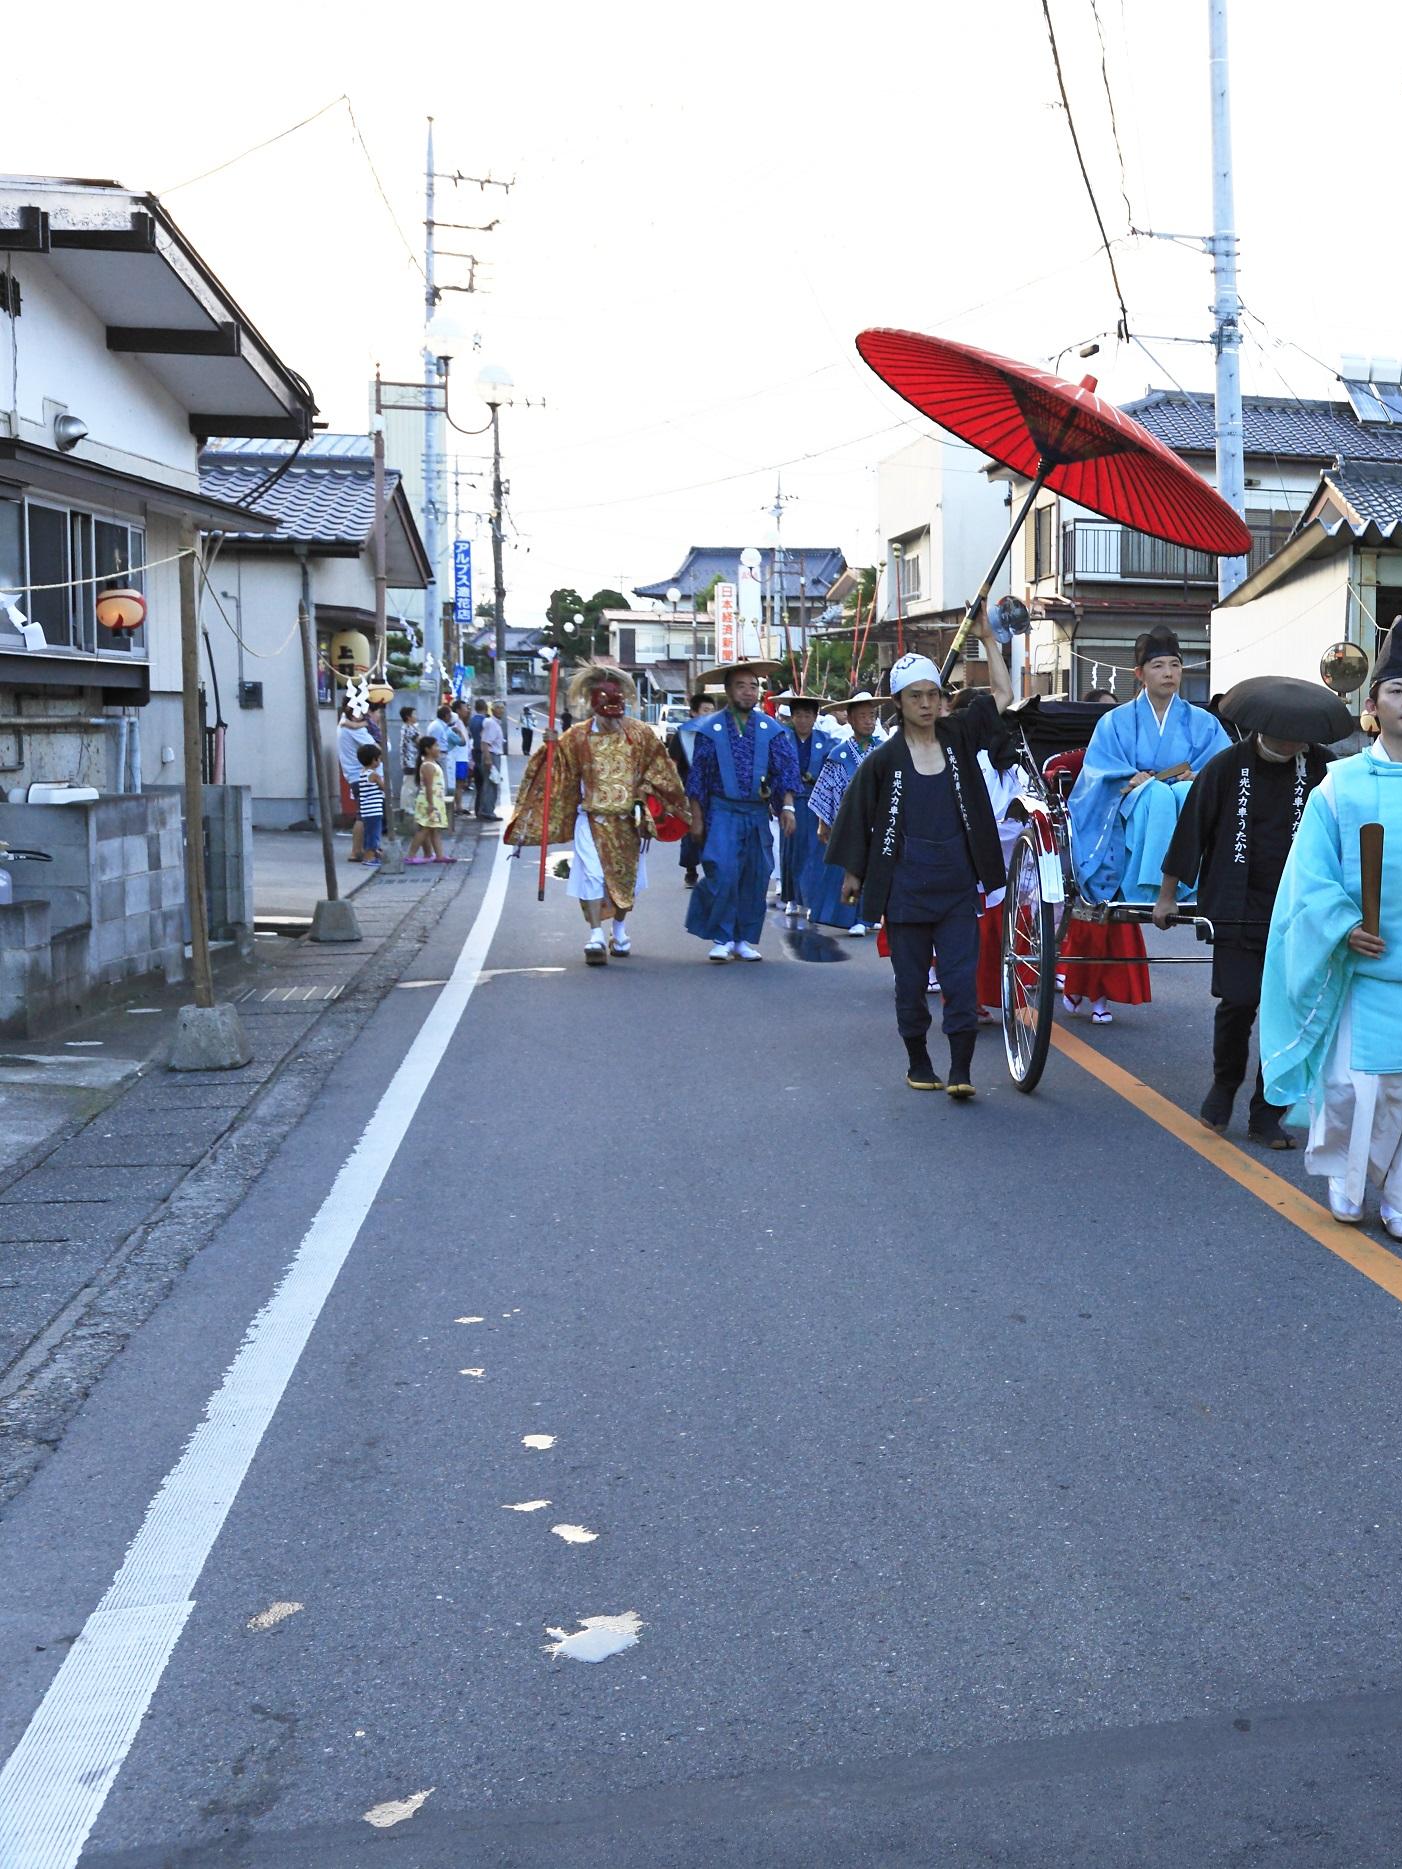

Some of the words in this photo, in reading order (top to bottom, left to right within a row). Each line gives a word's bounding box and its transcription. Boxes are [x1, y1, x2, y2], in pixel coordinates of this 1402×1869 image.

[722, 586, 734, 661] 日本経済新聞
[881, 770, 903, 857] 日光人力車うたかた
[1234, 767, 1251, 864] 日光人力車うたかた
